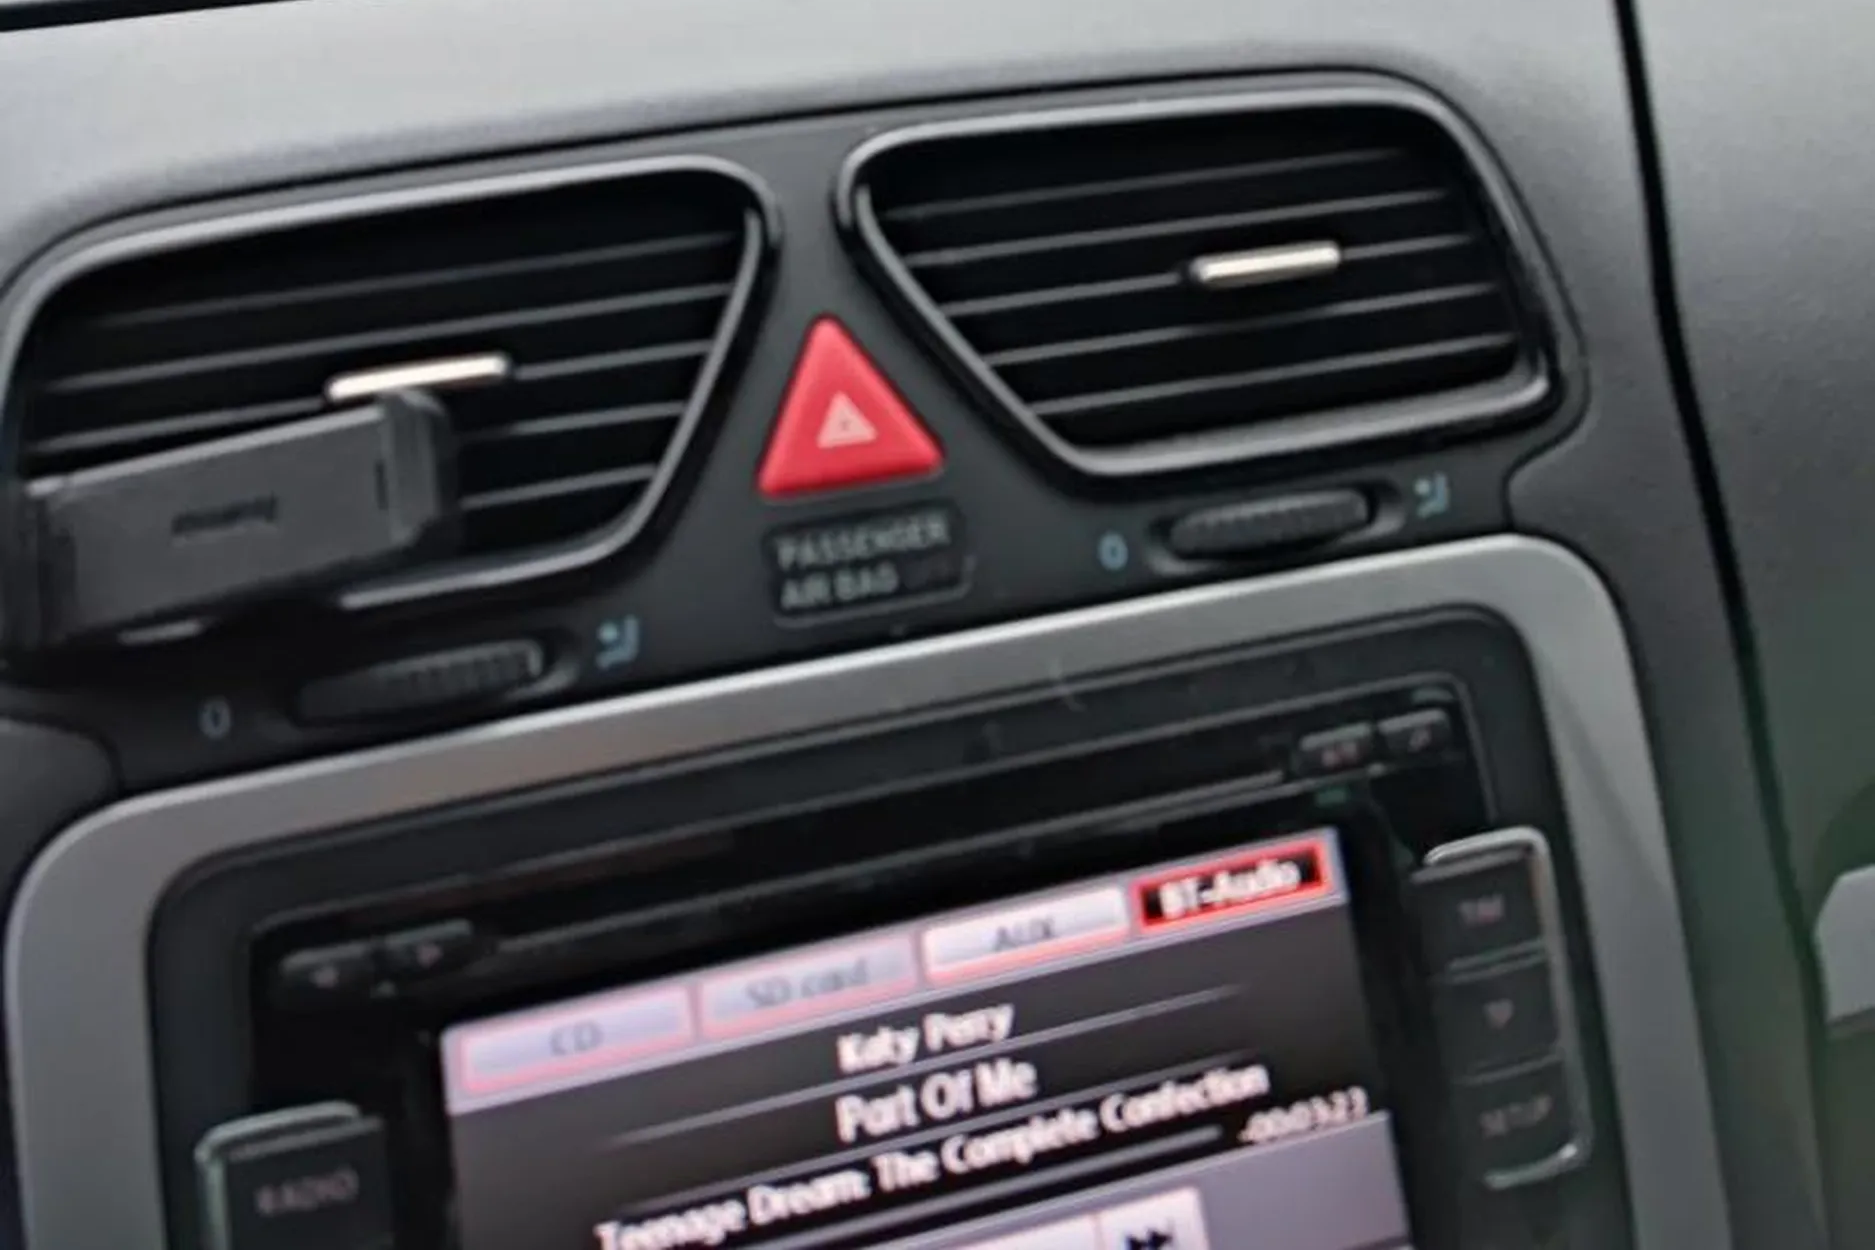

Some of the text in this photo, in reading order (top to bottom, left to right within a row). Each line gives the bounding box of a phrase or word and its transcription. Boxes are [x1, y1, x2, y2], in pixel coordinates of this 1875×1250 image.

[776, 512, 951, 571] PASSENGER
[1159, 858, 1300, 919] BT-Audio
[549, 1019, 604, 1057] CD
[837, 1003, 1014, 1072] Katy Perry
[836, 1058, 1037, 1143] Part Of Me
[593, 1200, 747, 1250] Teenage
[873, 1150, 940, 1193] The
[941, 1107, 1098, 1175] Complete
[1099, 1064, 1271, 1133] Confection
